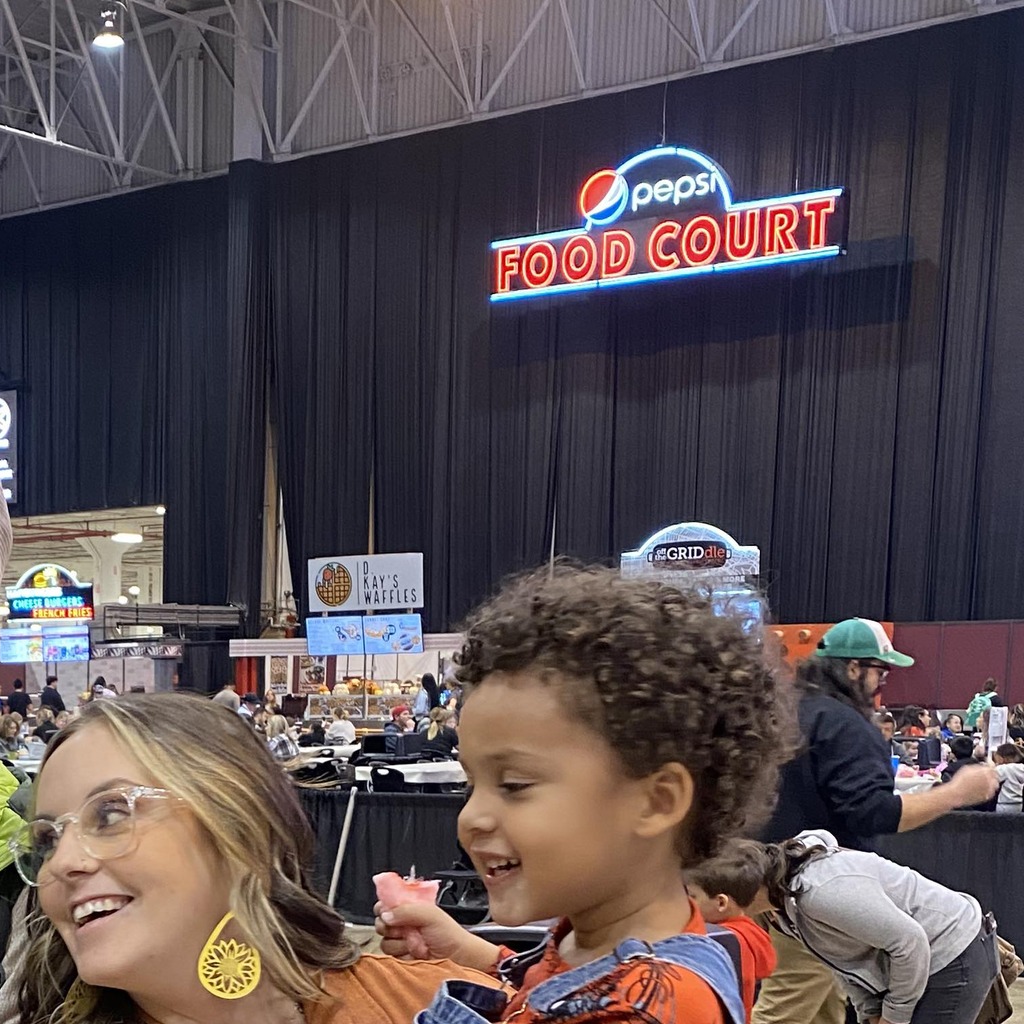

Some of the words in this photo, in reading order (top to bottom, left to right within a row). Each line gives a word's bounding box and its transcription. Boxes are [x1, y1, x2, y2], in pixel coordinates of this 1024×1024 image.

[631, 172, 719, 212] pepsi
[497, 230, 635, 294] FOOD
[648, 197, 836, 272] COURT
[655, 552, 667, 561] the
[656, 547, 667, 555] off
[666, 545, 726, 561] GRIDdle
[363, 574, 399, 590] KAY'S
[12, 598, 43, 610] CHEESE
[364, 588, 417, 605] WAFFLES
[32, 608, 66, 618] FRENCH
[67, 607, 92, 617] FRIES
